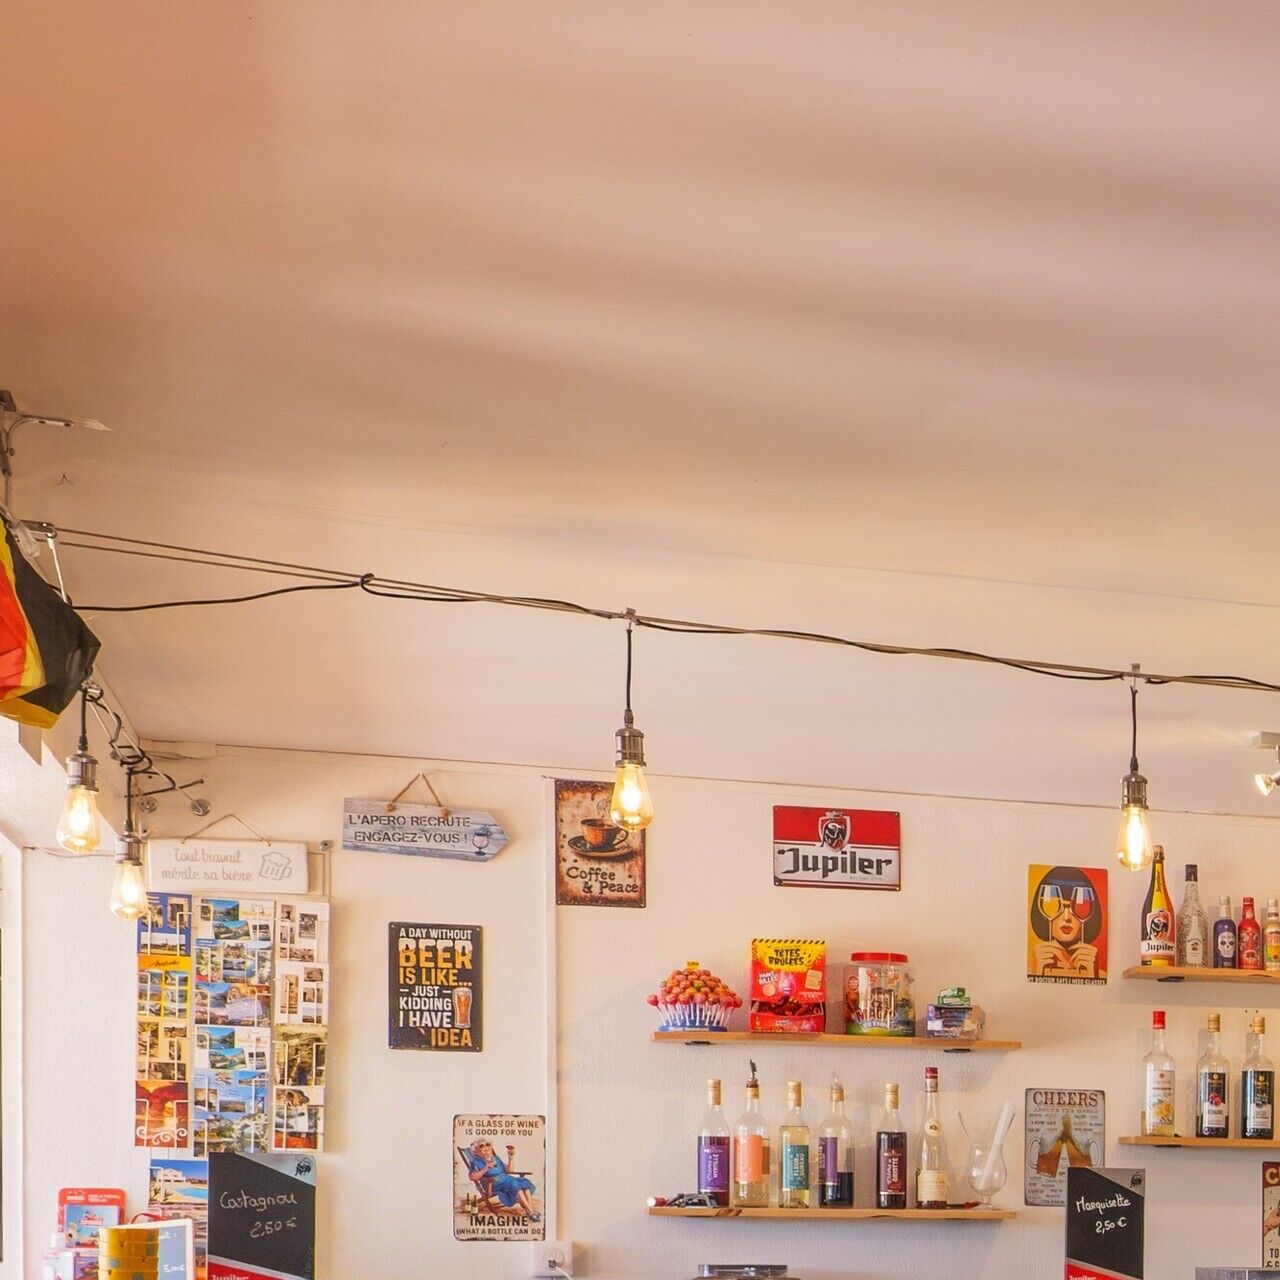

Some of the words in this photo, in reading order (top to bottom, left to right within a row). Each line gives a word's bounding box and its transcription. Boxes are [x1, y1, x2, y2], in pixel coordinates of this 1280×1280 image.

[410, 815, 471, 828] RECRUTE
[777, 848, 893, 879] Jupiler
[566, 866, 617, 881] Coffee
[582, 881, 594, 894] &
[598, 880, 639, 895] Peace
[399, 928, 406, 937] A
[409, 928, 427, 938] DAY
[430, 929, 473, 940] WITHOUT
[398, 938, 473, 969] BEER
[399, 967, 416, 985] IS
[411, 986, 440, 997] JUST
[399, 997, 452, 1011] KIDDING
[399, 1011, 404, 1027] I
[409, 1011, 452, 1028] HAVE
[431, 1028, 473, 1047] IDEA
[1033, 1091, 1099, 1107] CHEERS
[475, 1120, 503, 1128] GLASS
[505, 1120, 515, 1128] OF
[516, 1120, 540, 1129] WINE
[1076, 1193, 1132, 1214] Marquisette
[470, 1215, 529, 1227] IMAGINE
[1095, 1220, 1115, 1234] 2,50
[1117, 1217, 1127, 1228] €
[1270, 1248, 1280, 1259] TO
